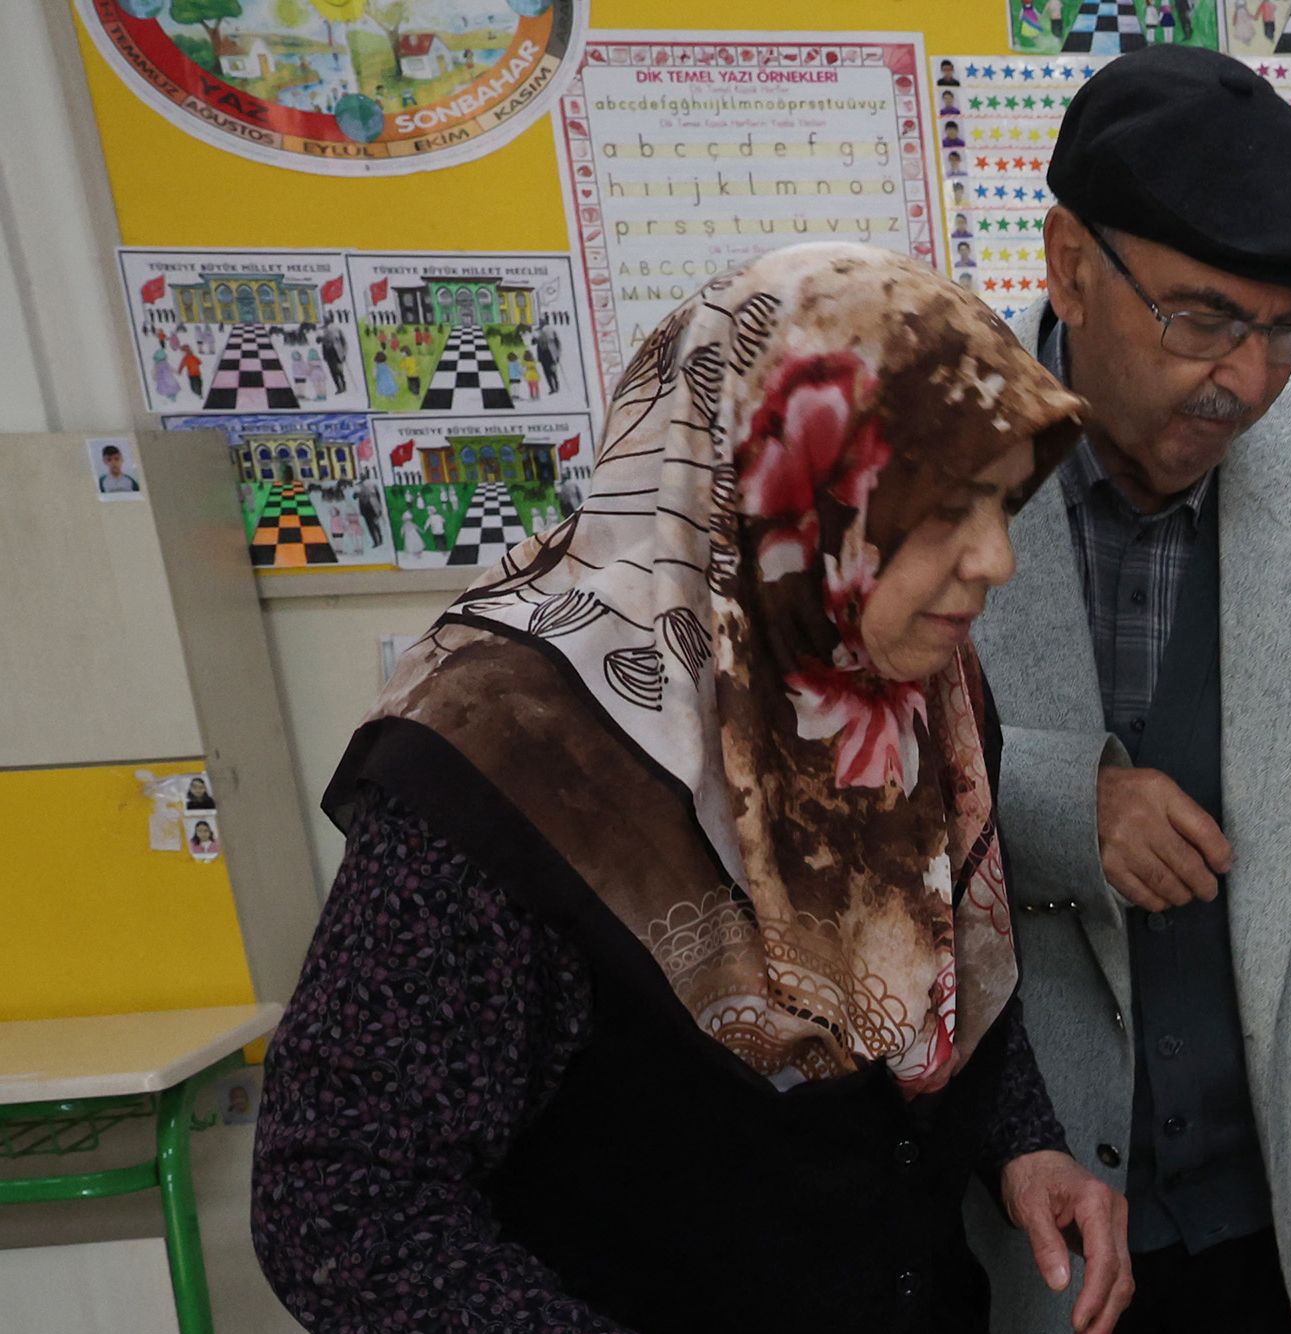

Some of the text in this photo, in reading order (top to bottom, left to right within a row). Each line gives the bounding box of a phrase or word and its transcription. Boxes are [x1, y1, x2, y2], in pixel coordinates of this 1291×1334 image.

[111, 25, 180, 96] TEMMUZ
[637, 68, 838, 83] DİK TEMEL YAZI ÖRNEKLERİ
[201, 77, 269, 121] YAZ
[395, 39, 539, 133] SONBAHAR
[495, 67, 551, 120] KASIM
[186, 100, 275, 145] AĞUSTOS
[303, 141, 374, 157] EYLÜL
[621, 285, 684, 300] M N O
